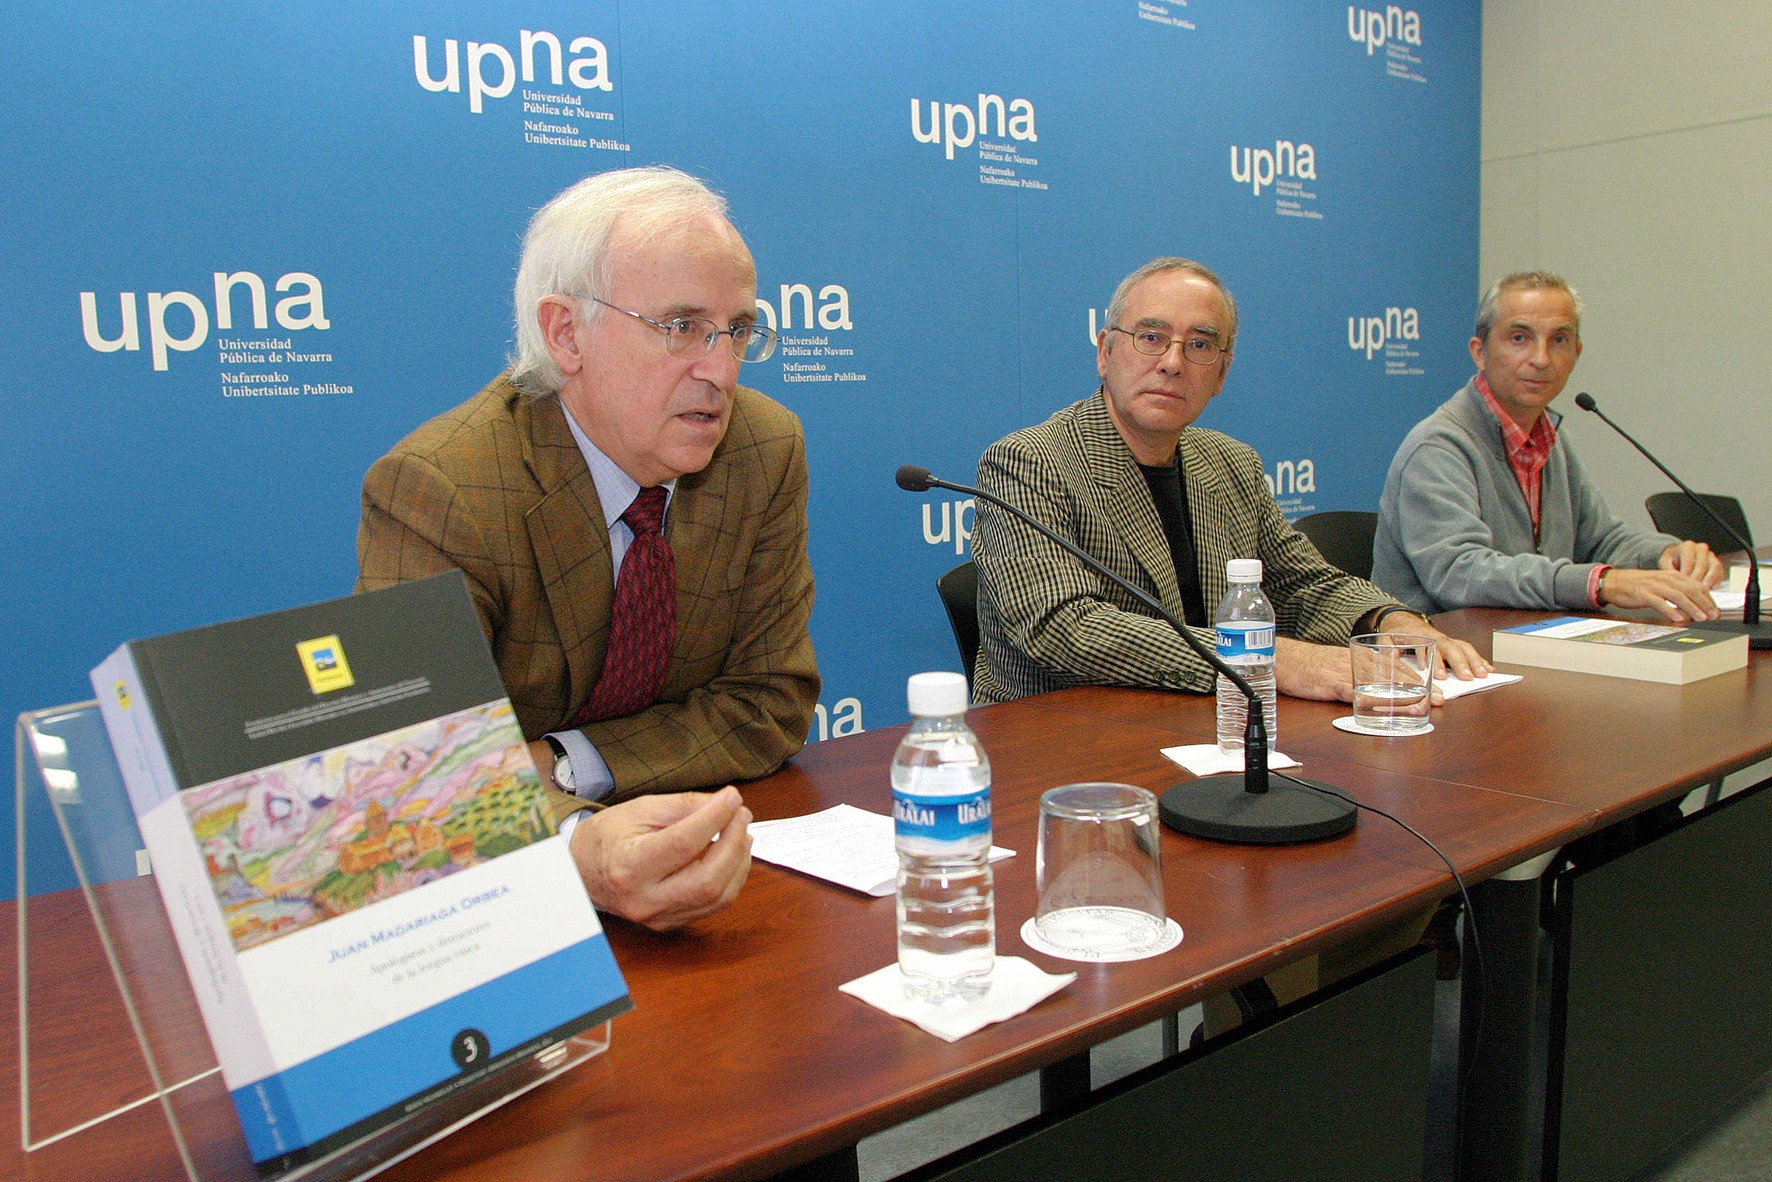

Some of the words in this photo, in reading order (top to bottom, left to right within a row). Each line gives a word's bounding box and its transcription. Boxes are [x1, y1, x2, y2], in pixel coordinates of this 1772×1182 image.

[1348, 5, 1422, 56] upna
[413, 29, 613, 114] upna
[522, 89, 582, 105] Universidad
[523, 102, 560, 117] Pública
[562, 105, 575, 118] de
[577, 108, 614, 121] Navarra
[524, 121, 579, 135] Nafarroako
[911, 93, 1037, 160] upna
[525, 133, 587, 148] Unibertsitate
[590, 139, 631, 152] Publikoa
[1231, 140, 1316, 196] upna
[79, 271, 331, 371] upna
[782, 336, 828, 346] Universidad
[1348, 307, 1420, 360] upna
[218, 338, 292, 350] Universidad
[782, 347, 811, 356] Pública
[813, 347, 822, 356] de
[824, 347, 854, 356] Navarra
[220, 352, 265, 364] Pública
[269, 352, 282, 363] de
[286, 352, 333, 363] Navarra
[783, 363, 826, 372] Nafarroako
[220, 372, 289, 384] Nafarroako
[783, 372, 832, 382] Unibertsitate
[834, 372, 867, 381] Publikoa
[222, 385, 300, 398] Unibertsitate
[303, 384, 353, 395] Publikoa
[922, 499, 976, 555] up
[328, 940, 370, 964] JUAN
[370, 905, 458, 946] MADARIAGA
[463, 1035, 478, 1063] 3
